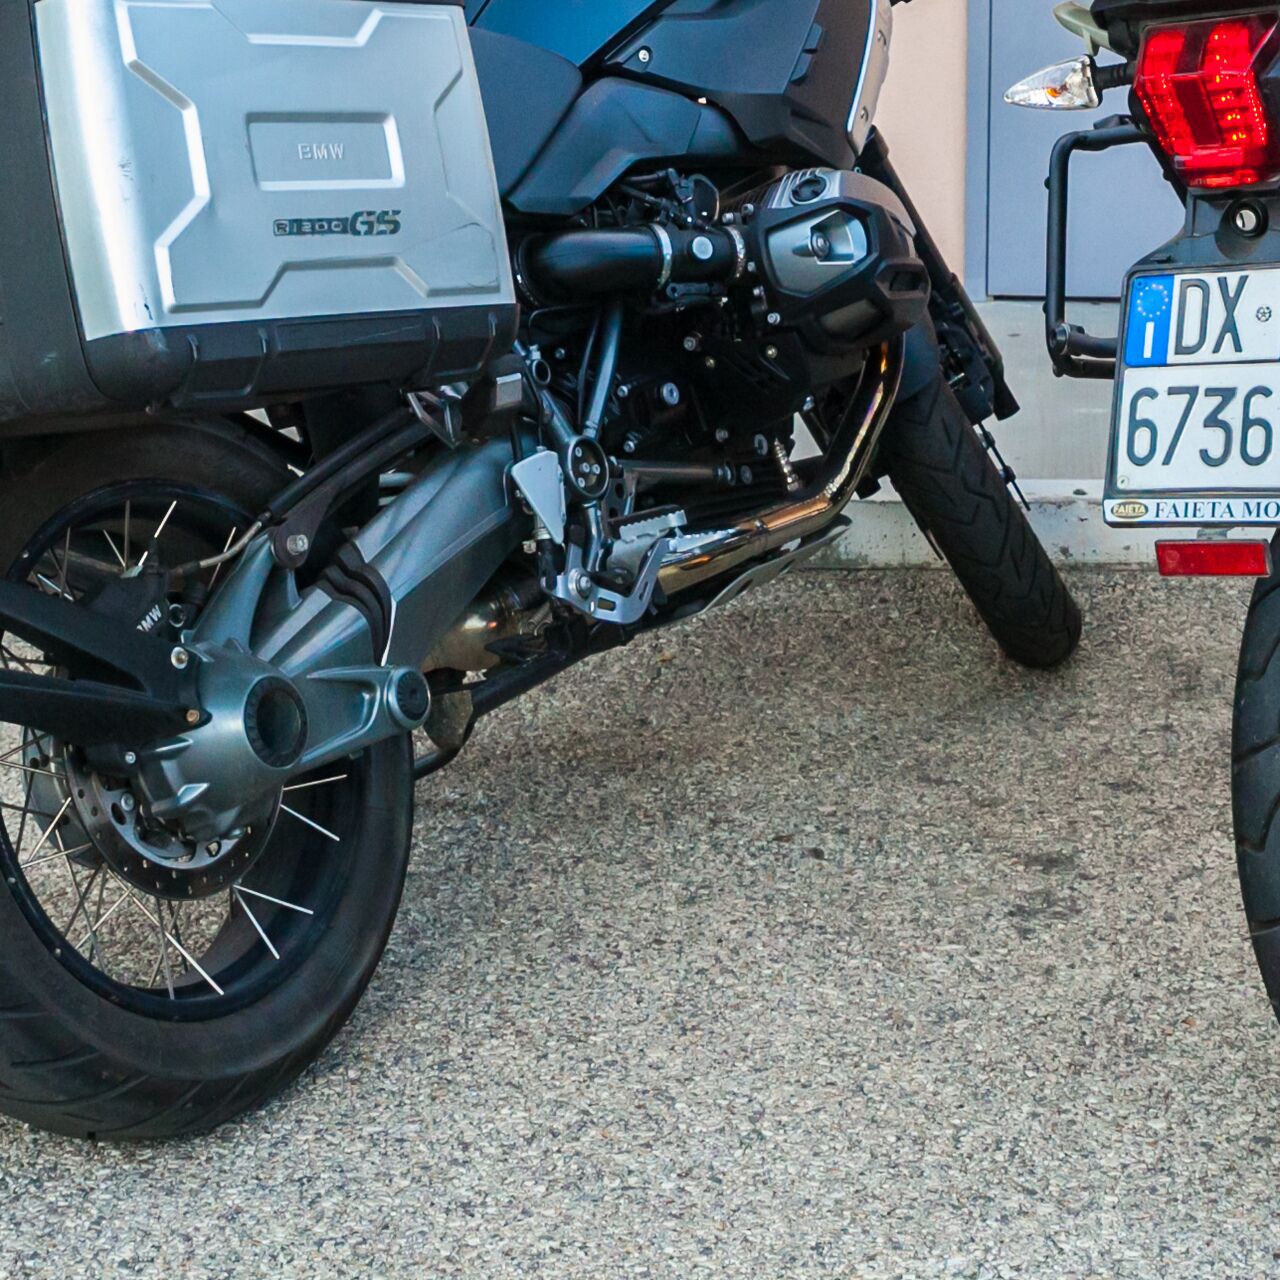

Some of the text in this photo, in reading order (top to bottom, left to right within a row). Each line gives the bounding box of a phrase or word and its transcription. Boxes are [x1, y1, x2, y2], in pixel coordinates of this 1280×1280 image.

[298, 143, 344, 160] BMW
[1173, 275, 1249, 356] DX
[1113, 504, 1147, 515] FAIETA
[1154, 501, 1234, 518] FAIETA
